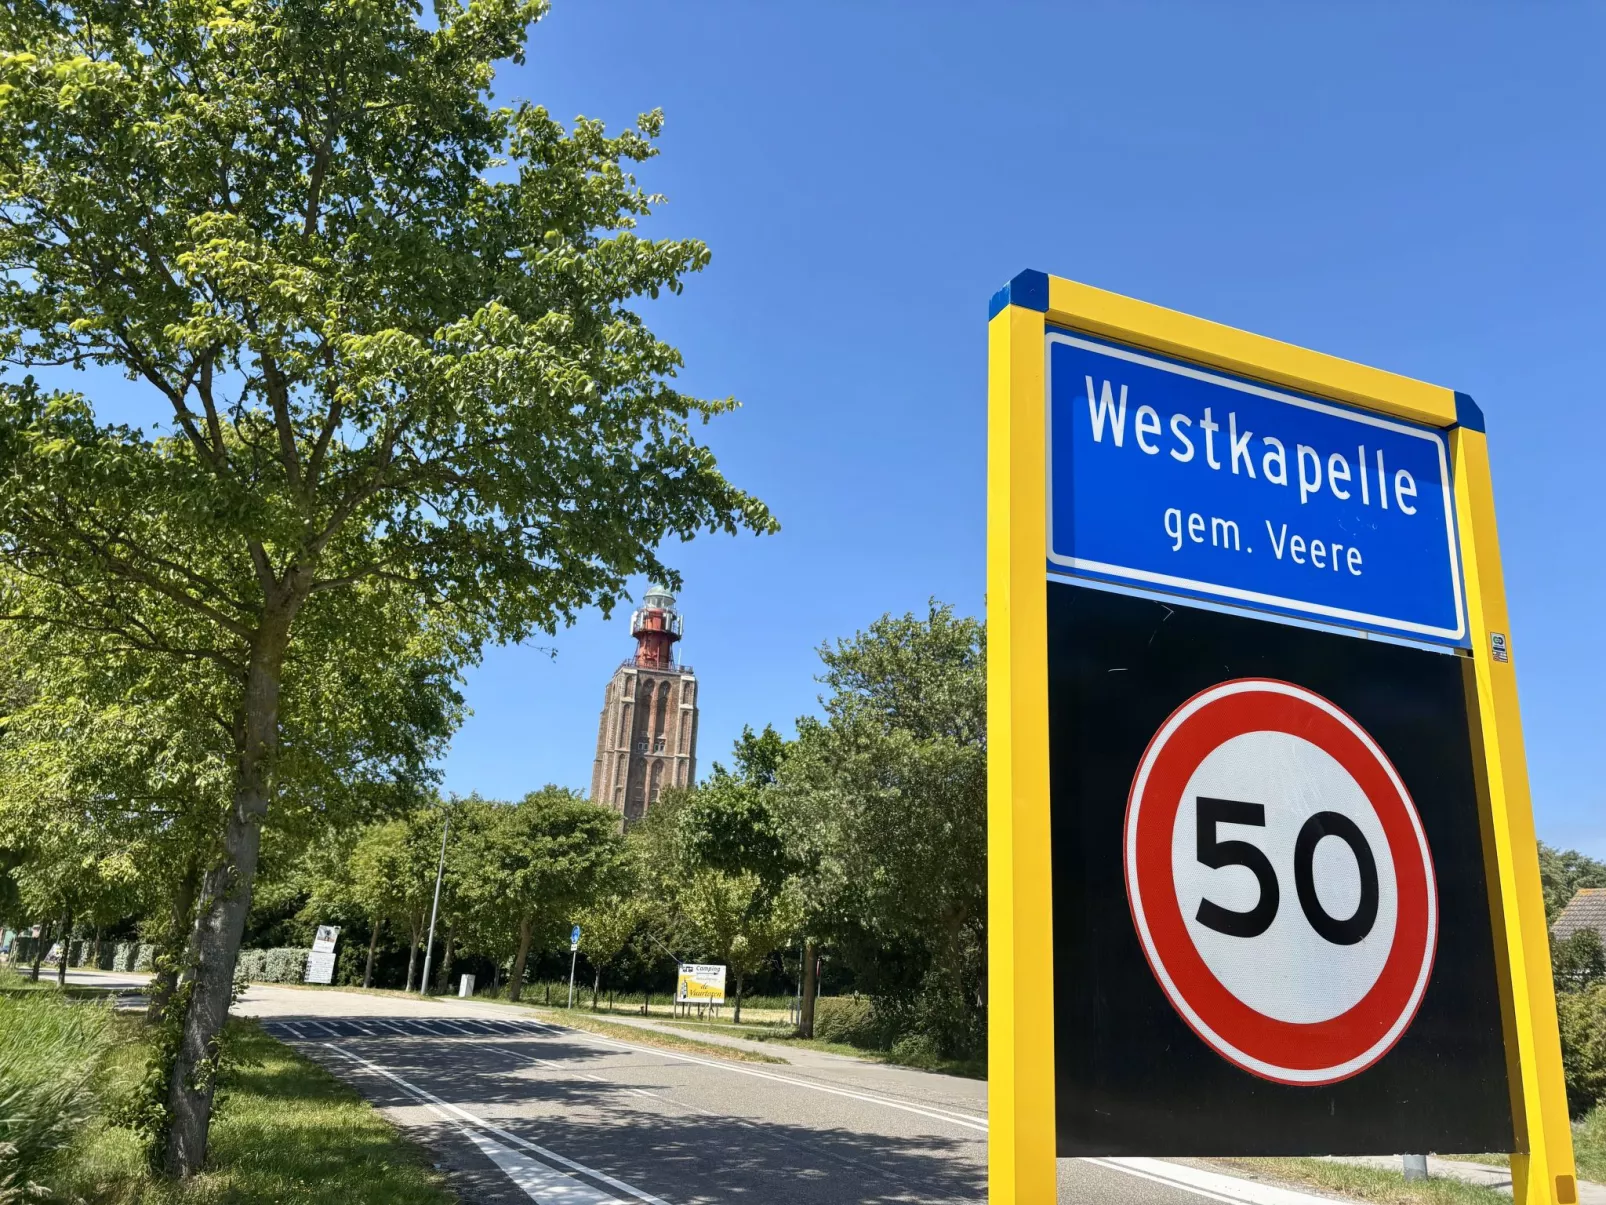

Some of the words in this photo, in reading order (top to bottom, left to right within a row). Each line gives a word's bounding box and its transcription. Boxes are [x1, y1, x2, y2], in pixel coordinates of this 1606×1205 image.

[1084, 375, 1418, 515] Westkapelle
[1164, 507, 1253, 553] gem.
[1265, 519, 1363, 576] Veere
[1196, 796, 1379, 945] 50
